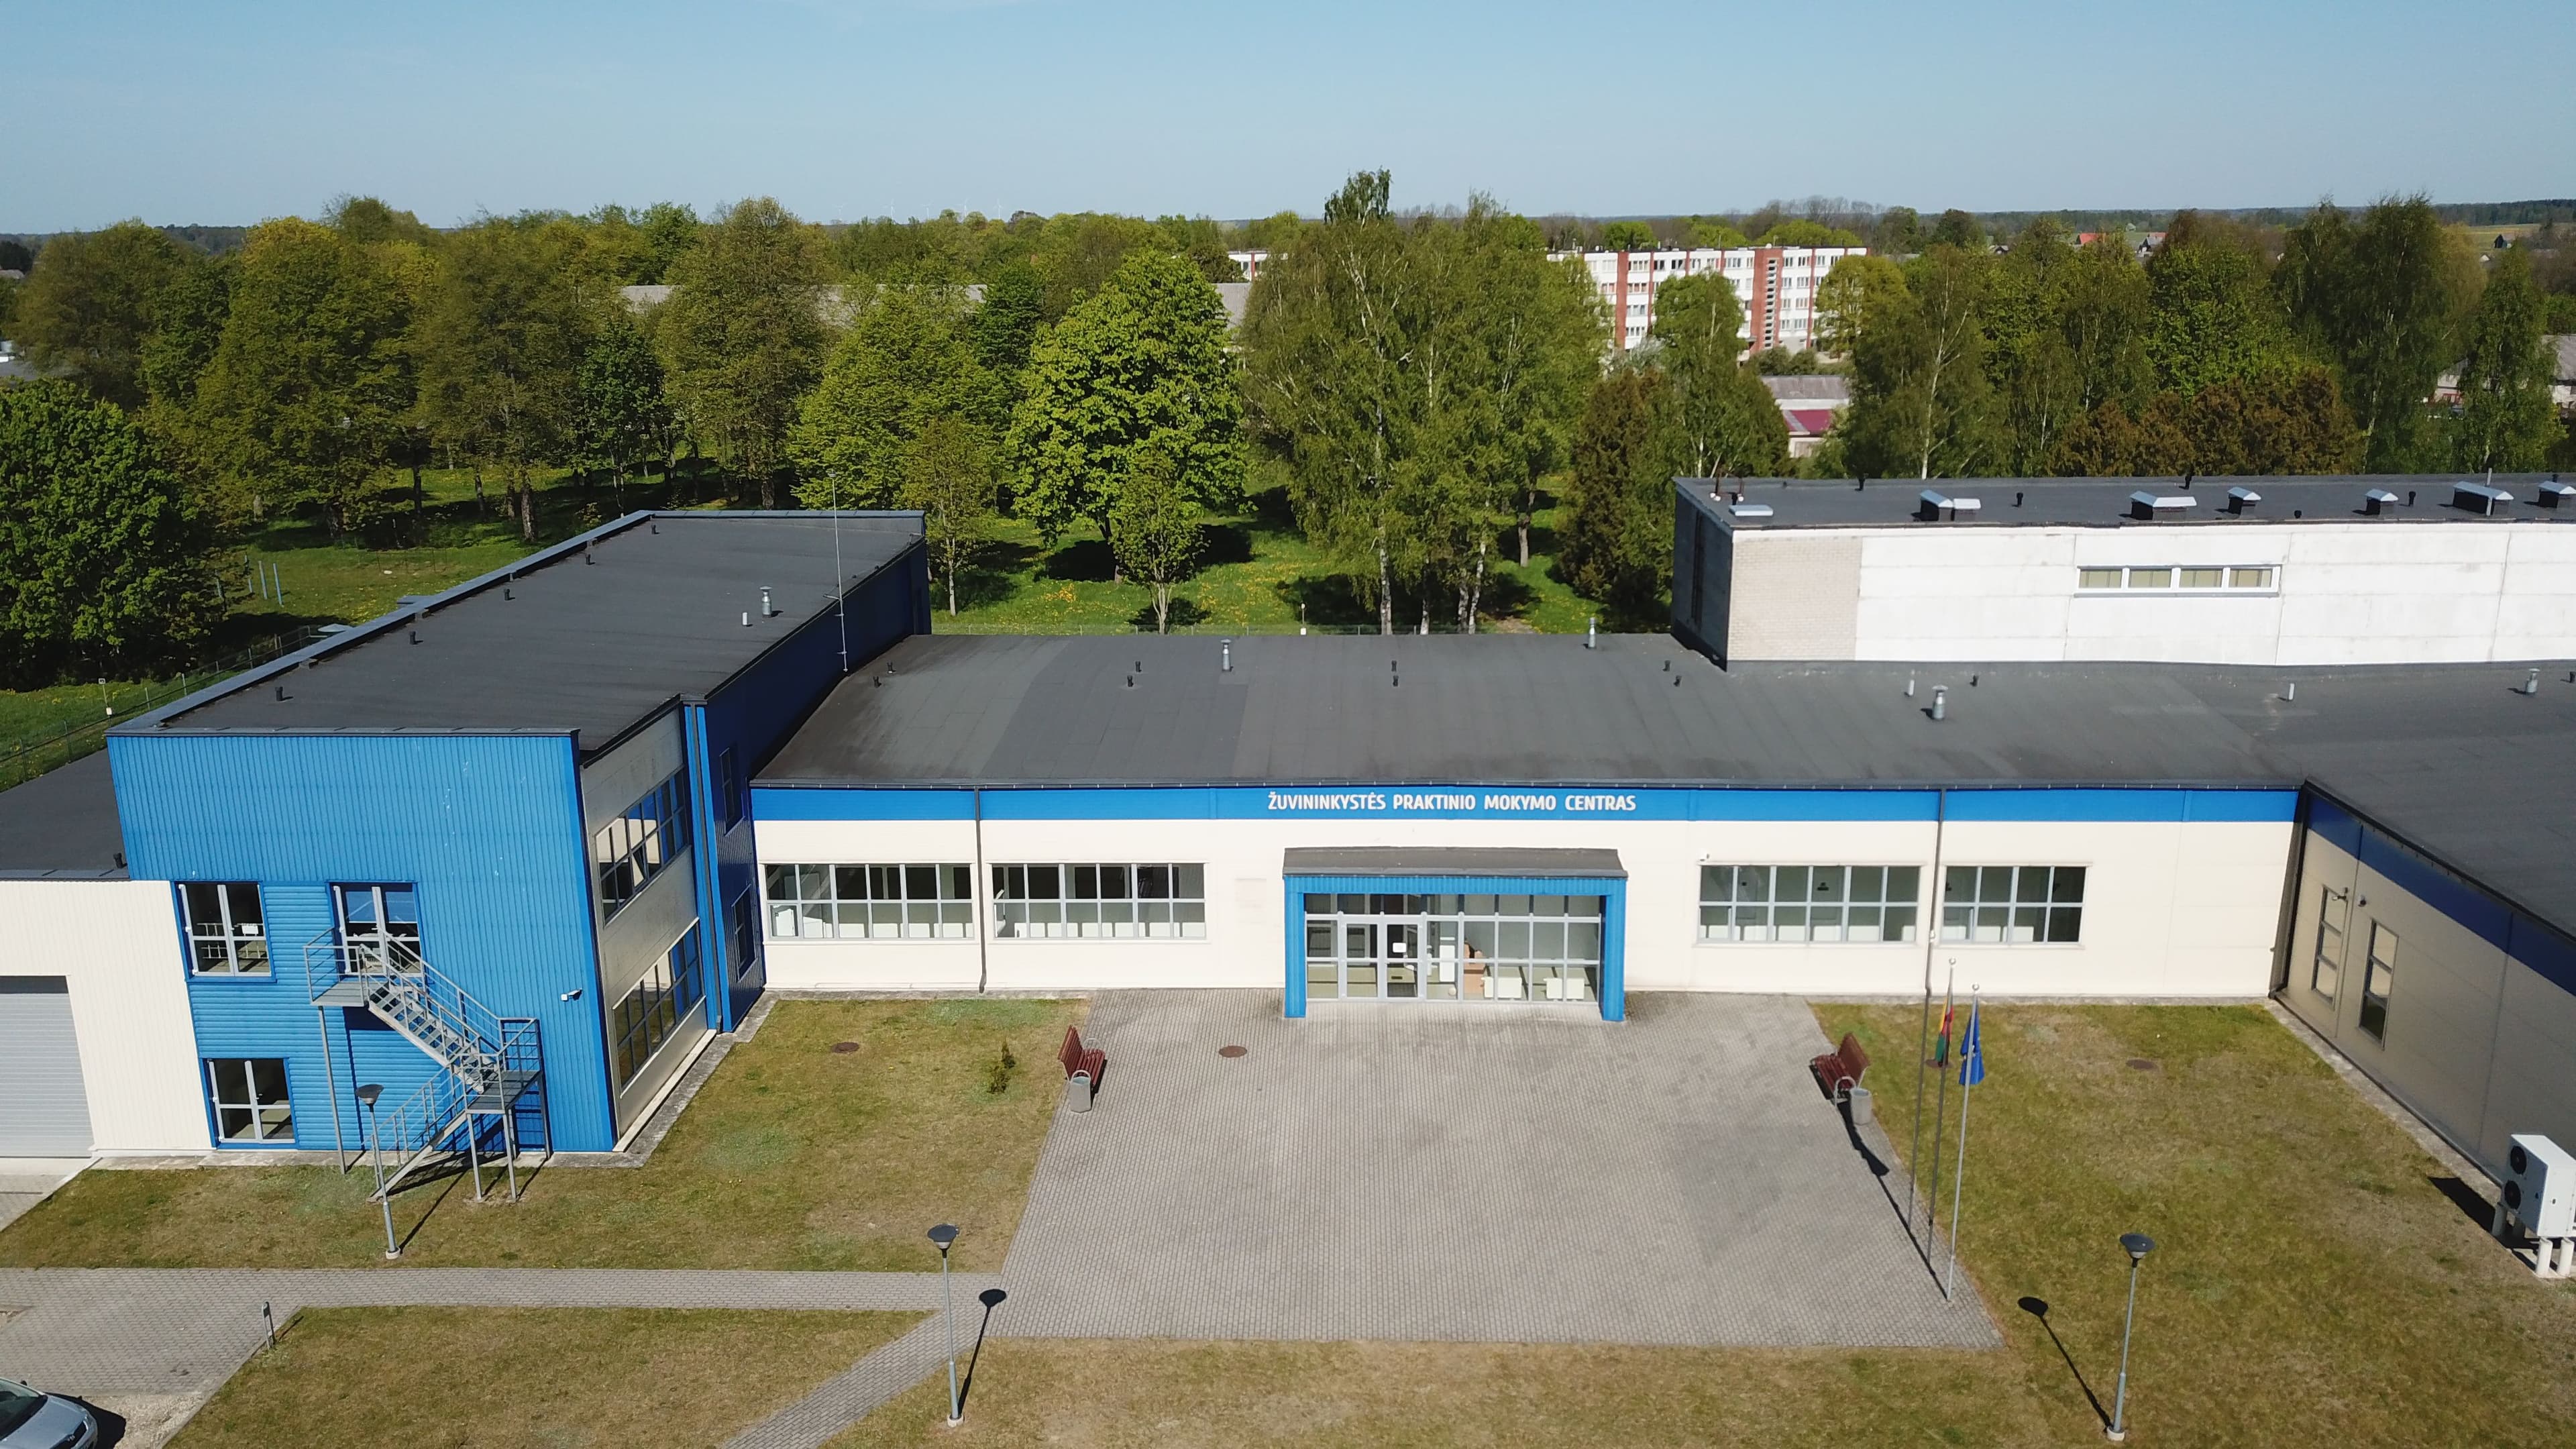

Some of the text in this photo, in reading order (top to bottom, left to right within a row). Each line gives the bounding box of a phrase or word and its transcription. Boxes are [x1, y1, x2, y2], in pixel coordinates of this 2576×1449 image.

[1268, 791, 1636, 811] ŽUVININKYSTĖS PRAKTINIO MOKYMO CENTRAS
